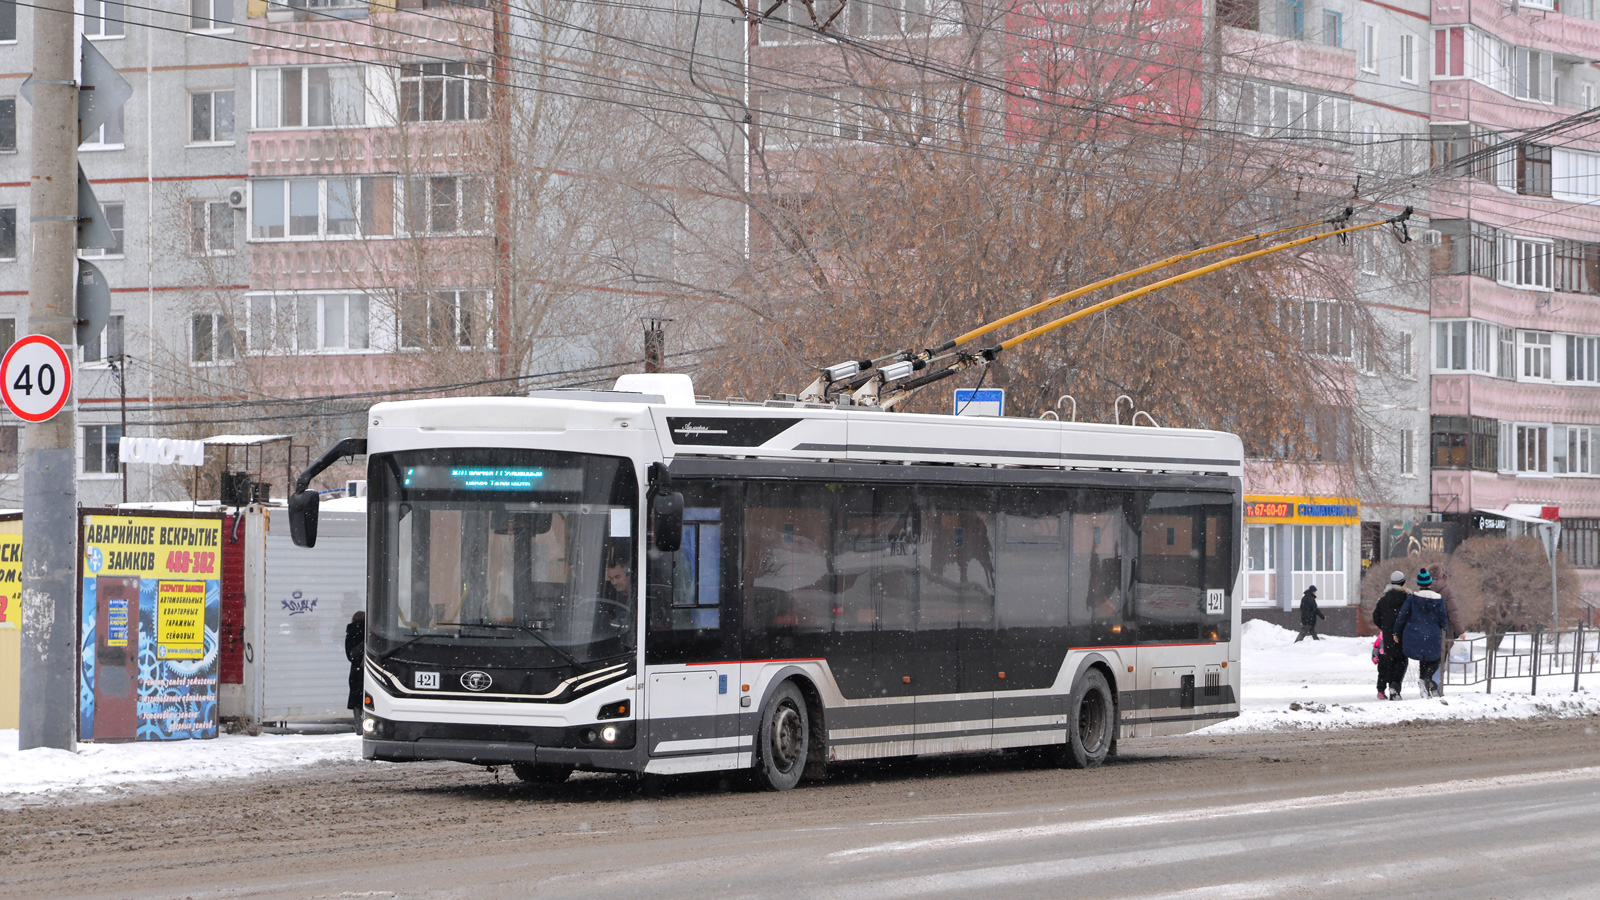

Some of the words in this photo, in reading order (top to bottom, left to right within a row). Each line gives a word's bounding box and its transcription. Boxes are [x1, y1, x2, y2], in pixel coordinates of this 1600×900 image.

[13, 363, 55, 395] 40
[119, 437, 204, 466] КЛЮЧИ
[87, 520, 155, 545] АВАРИЙНОЕ
[160, 527, 218, 546] ВСКРЫТИЕ
[108, 551, 155, 570] ЗАМКОВ
[166, 551, 215, 573] 488-302
[160, 584, 184, 592] ВСКРЫТИЕ
[160, 596, 203, 604] АВТОМОБИЛЬНЫХ
[1208, 593, 1222, 610] 421
[166, 631, 195, 639] СЕЙФОВЫХ
[417, 674, 436, 686] 421
